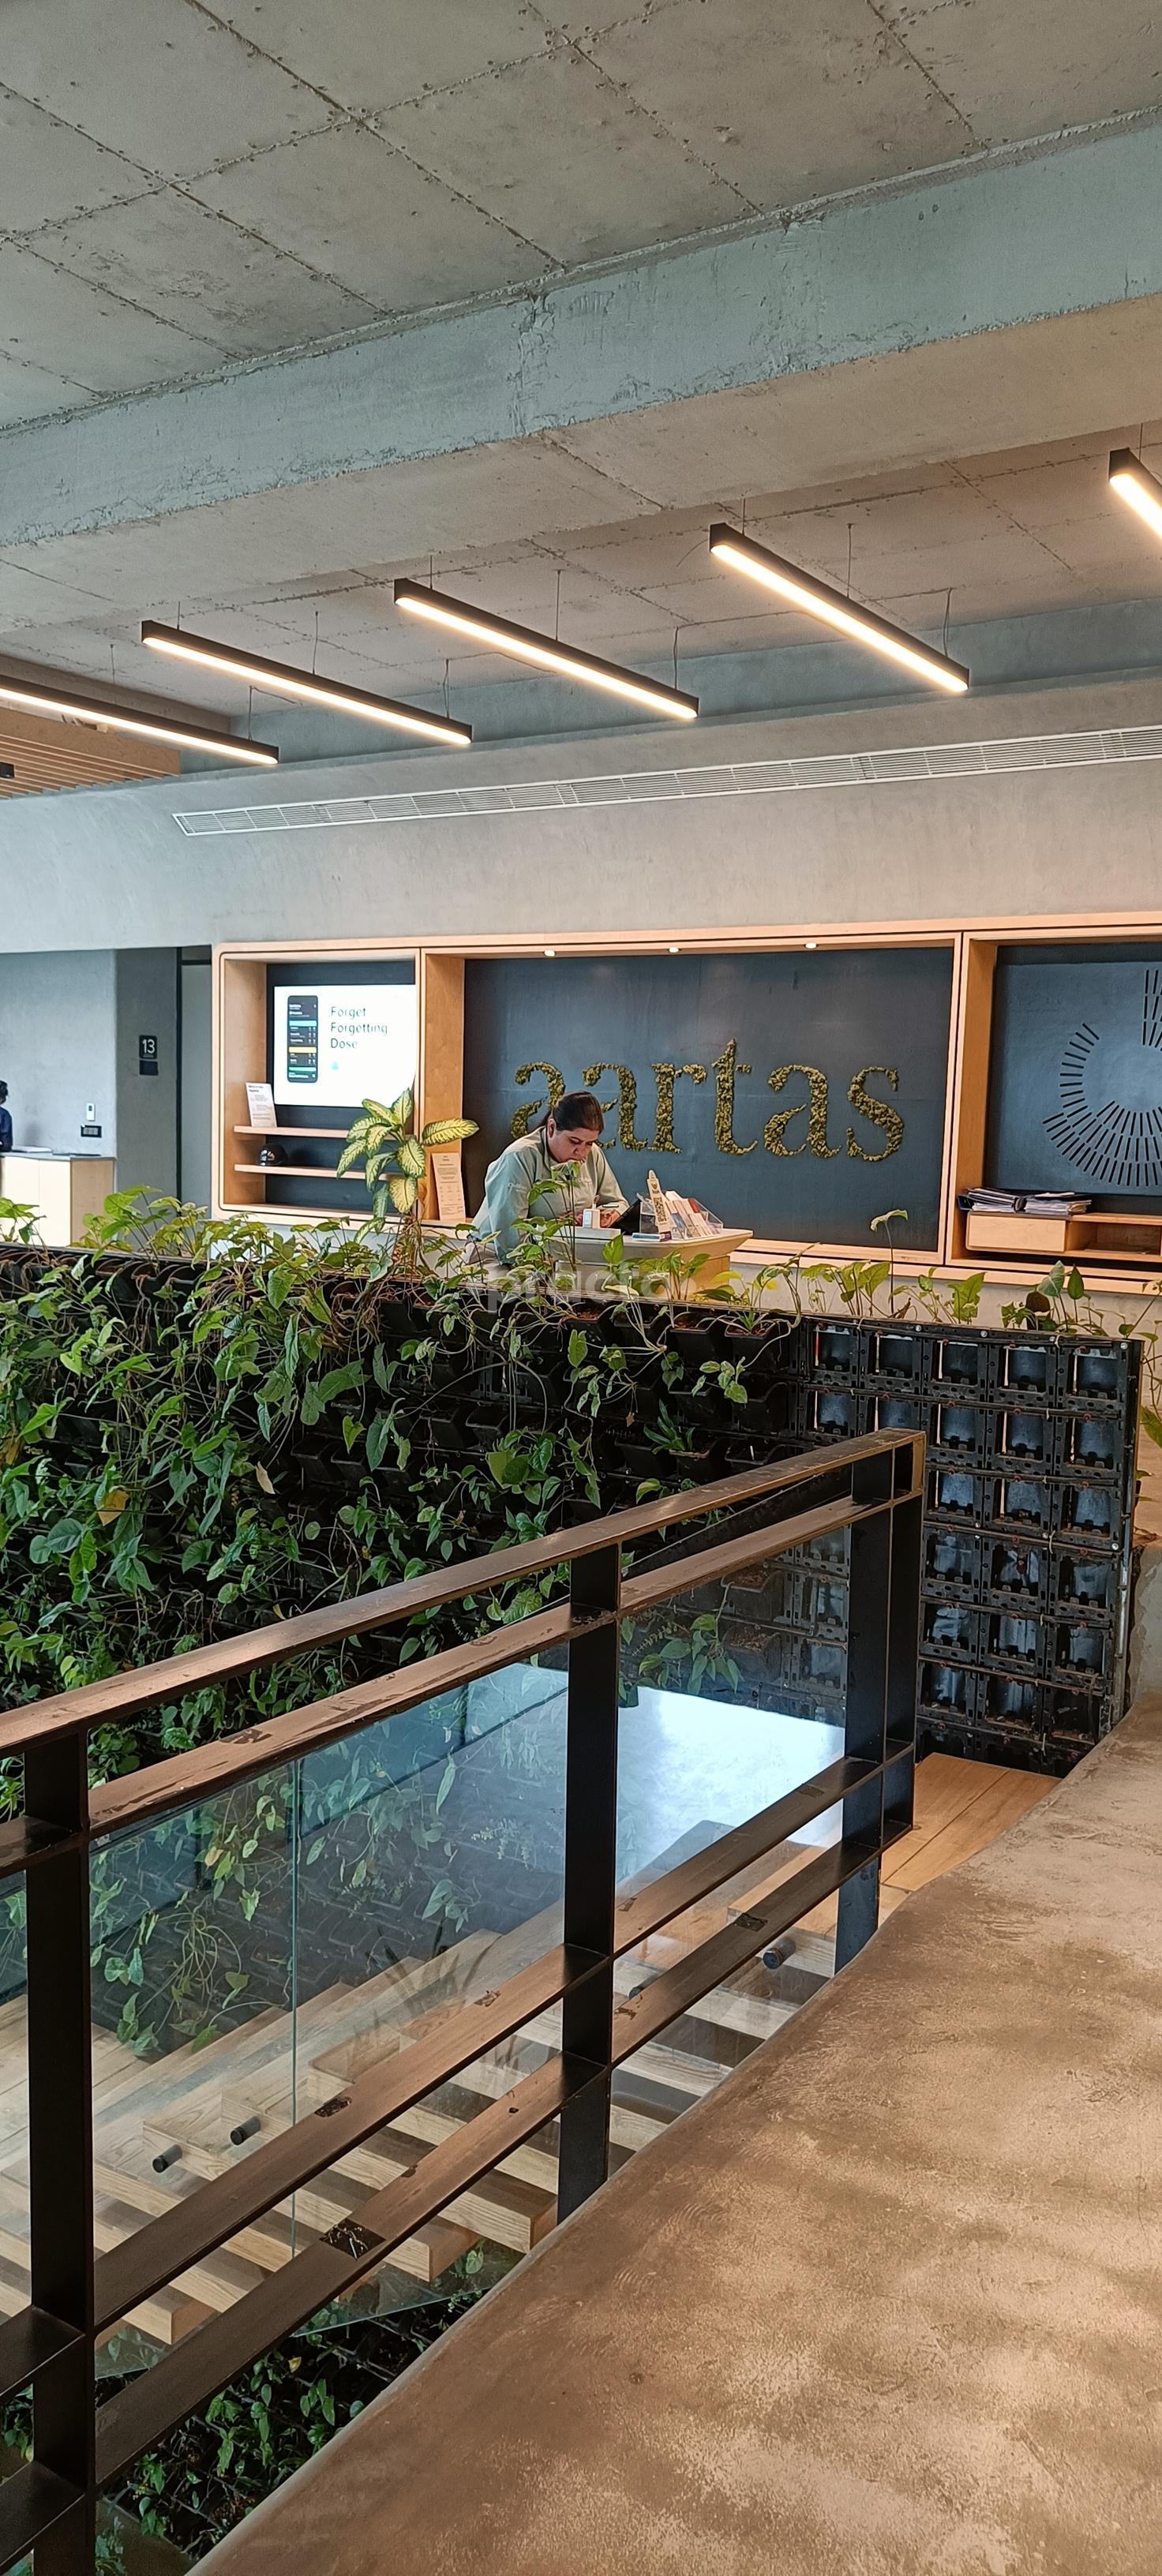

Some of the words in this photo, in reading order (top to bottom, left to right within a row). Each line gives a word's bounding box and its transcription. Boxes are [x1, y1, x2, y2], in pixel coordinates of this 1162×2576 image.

[331, 1006, 365, 1020] Forget
[331, 1022, 387, 1035] Forgetting
[142, 1039, 155, 1054] 13
[330, 1038, 358, 1049] Dose
[511, 1039, 904, 1162] aartas
